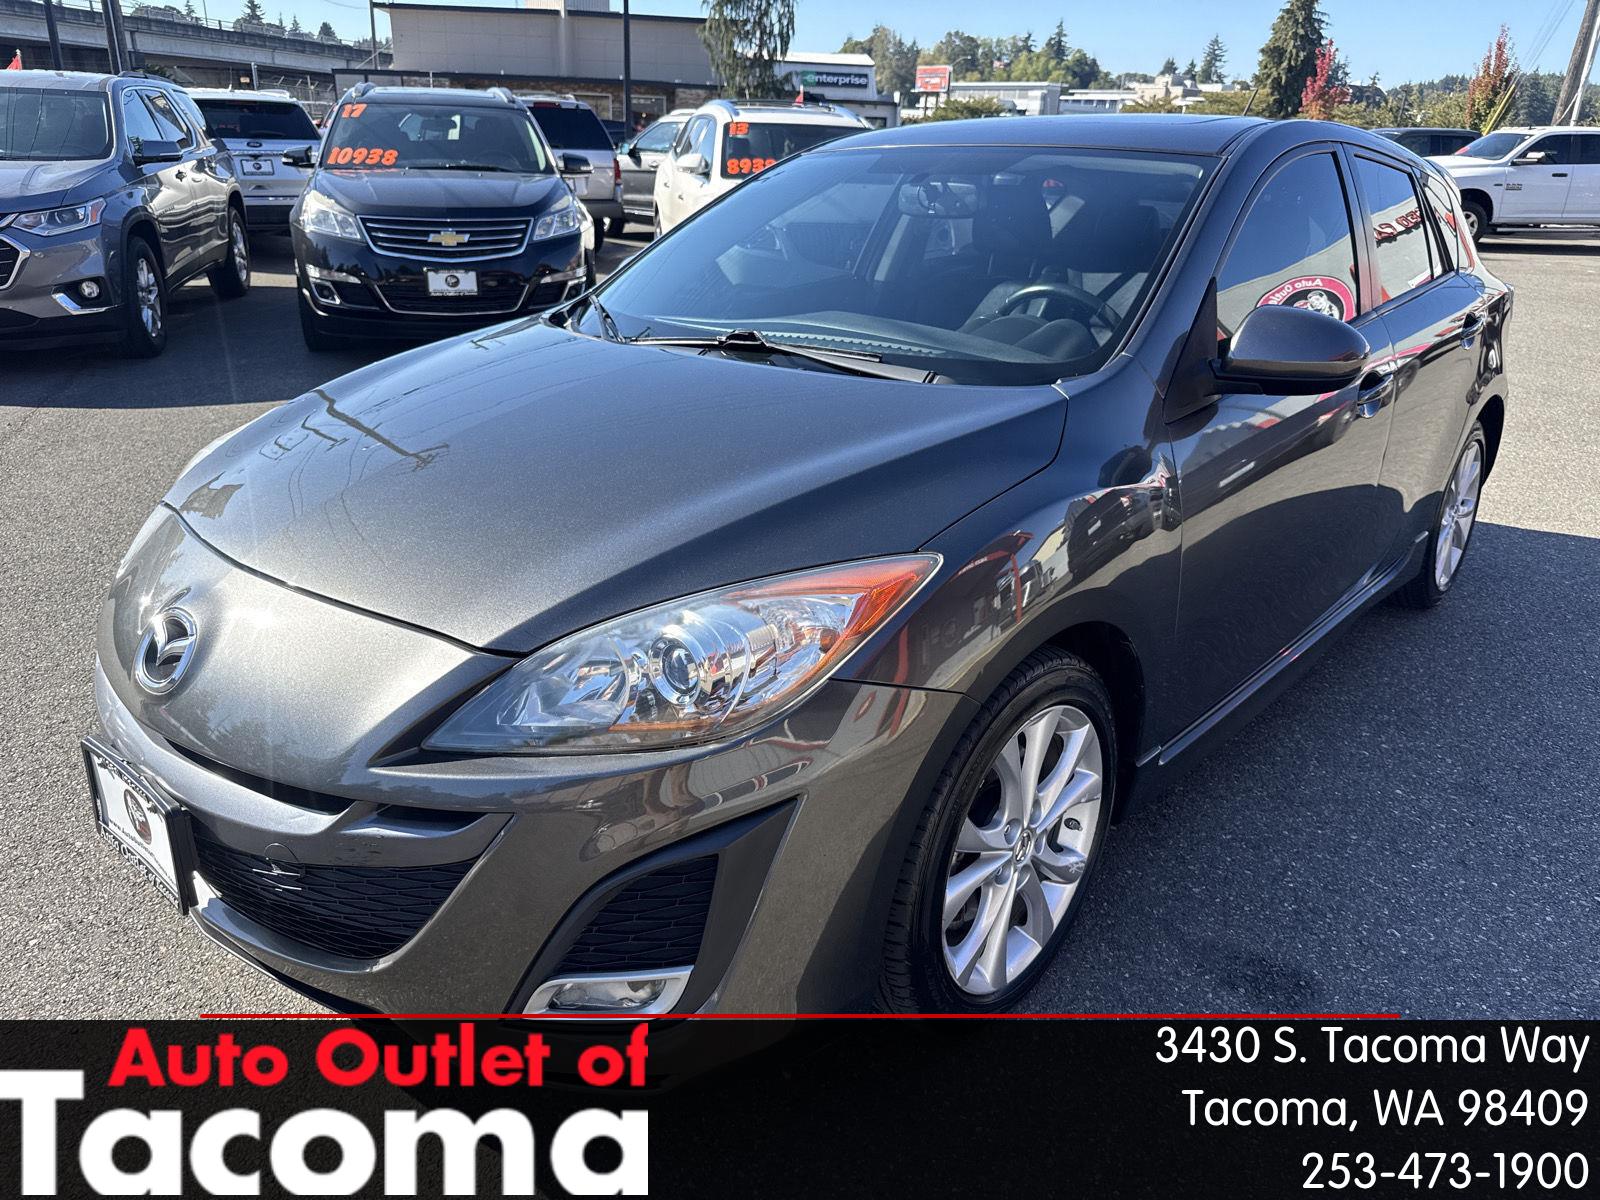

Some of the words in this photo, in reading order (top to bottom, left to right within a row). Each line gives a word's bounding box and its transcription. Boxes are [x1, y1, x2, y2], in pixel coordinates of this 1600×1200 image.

[806, 73, 868, 86] enterprise
[341, 103, 368, 118] 17
[327, 147, 399, 166] 10938
